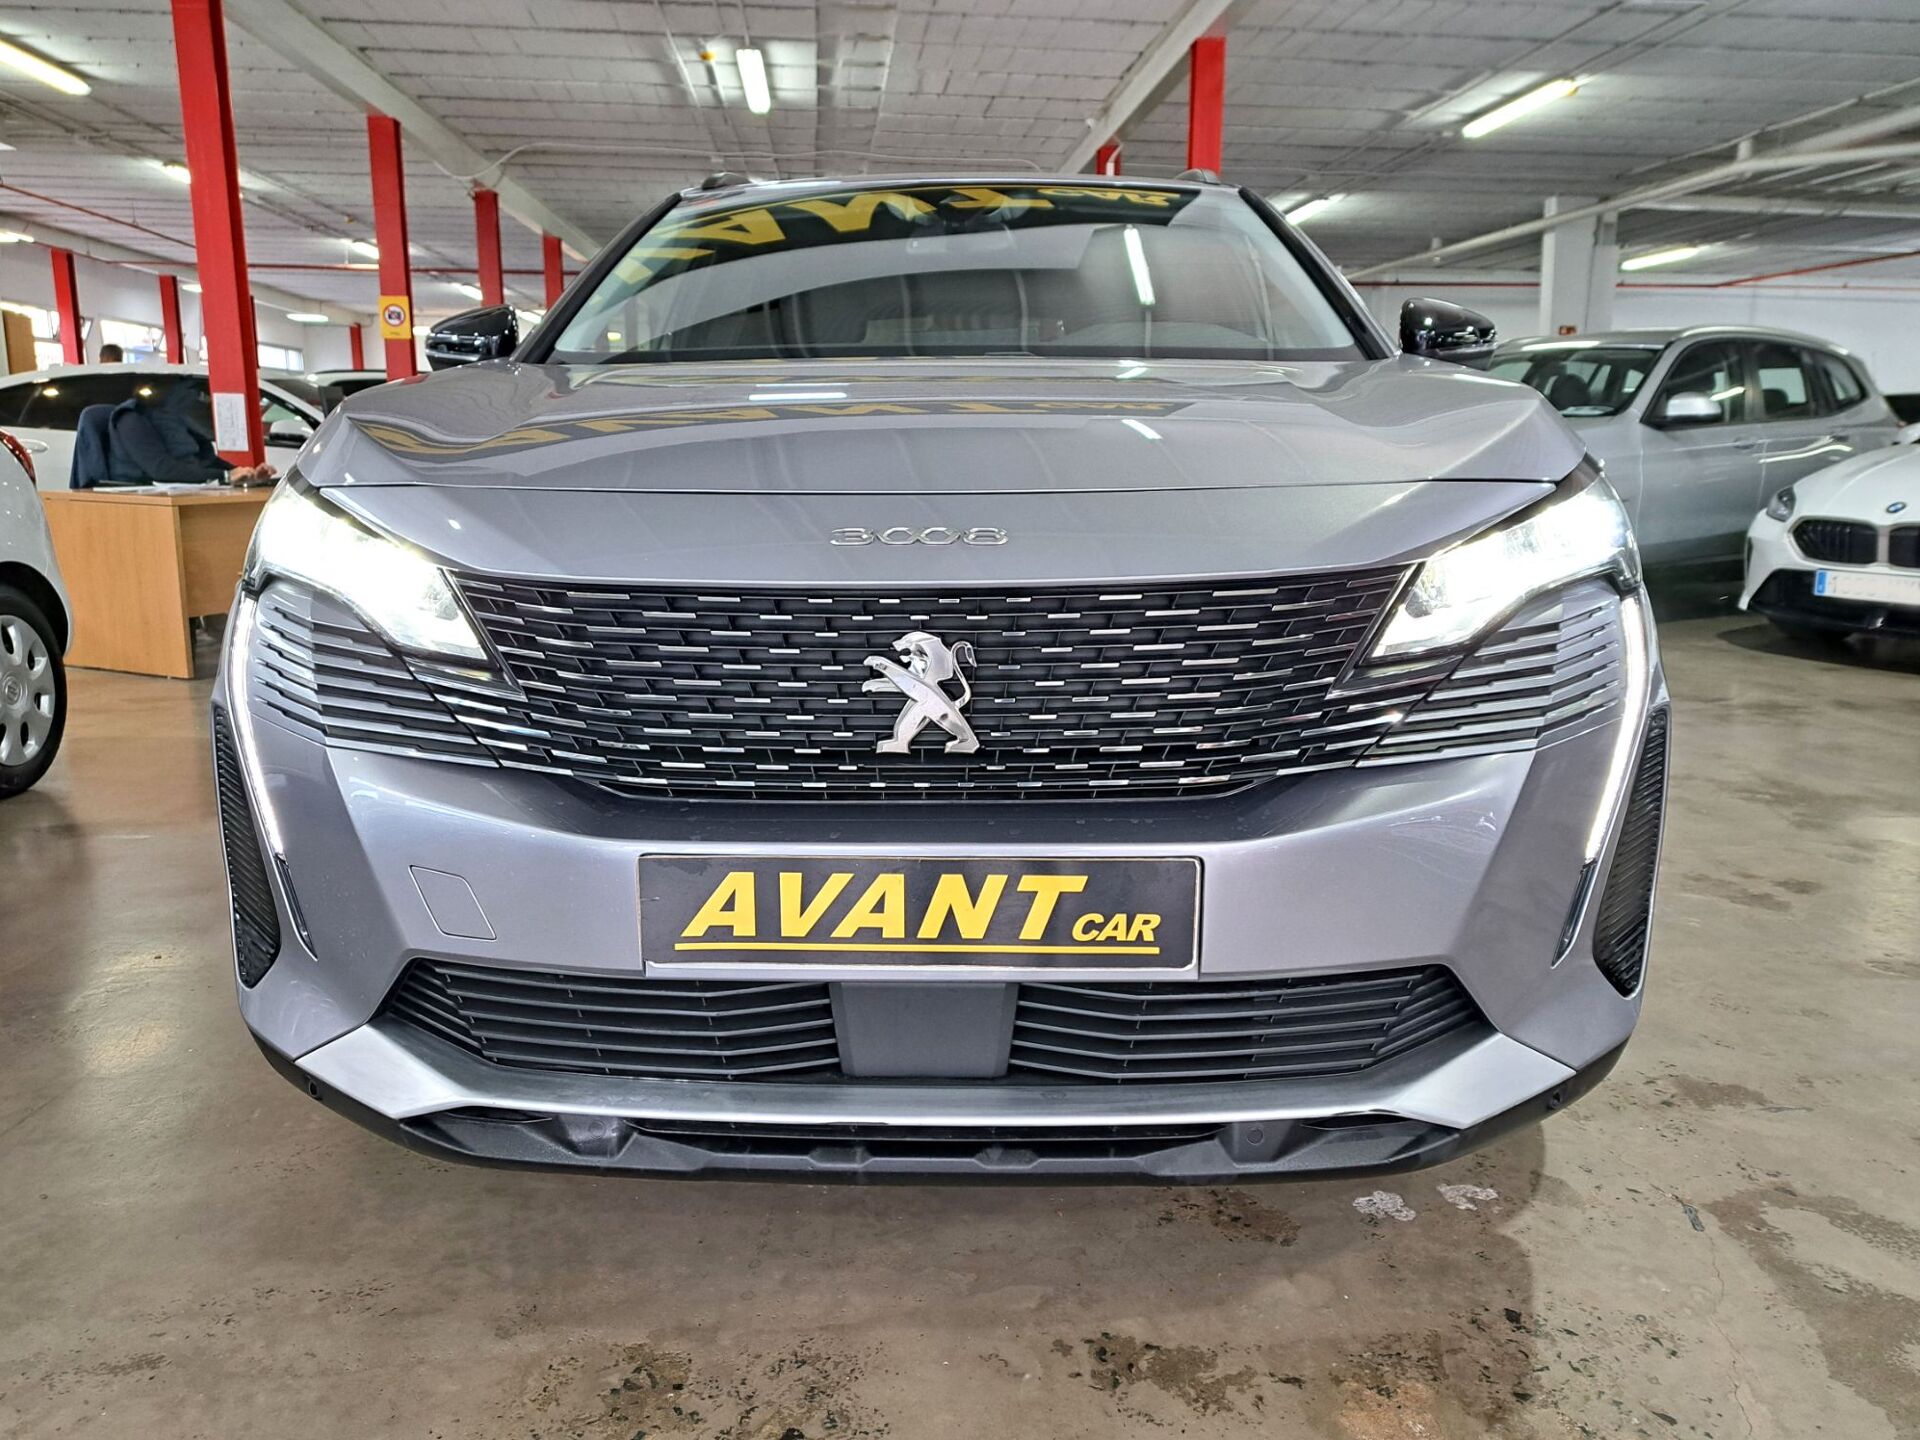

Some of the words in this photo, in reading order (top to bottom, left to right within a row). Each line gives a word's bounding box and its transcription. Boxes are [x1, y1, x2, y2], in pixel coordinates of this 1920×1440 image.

[830, 527, 1009, 546] 3008
[681, 872, 1089, 940] AVANT
[1071, 912, 1161, 942] CAR
